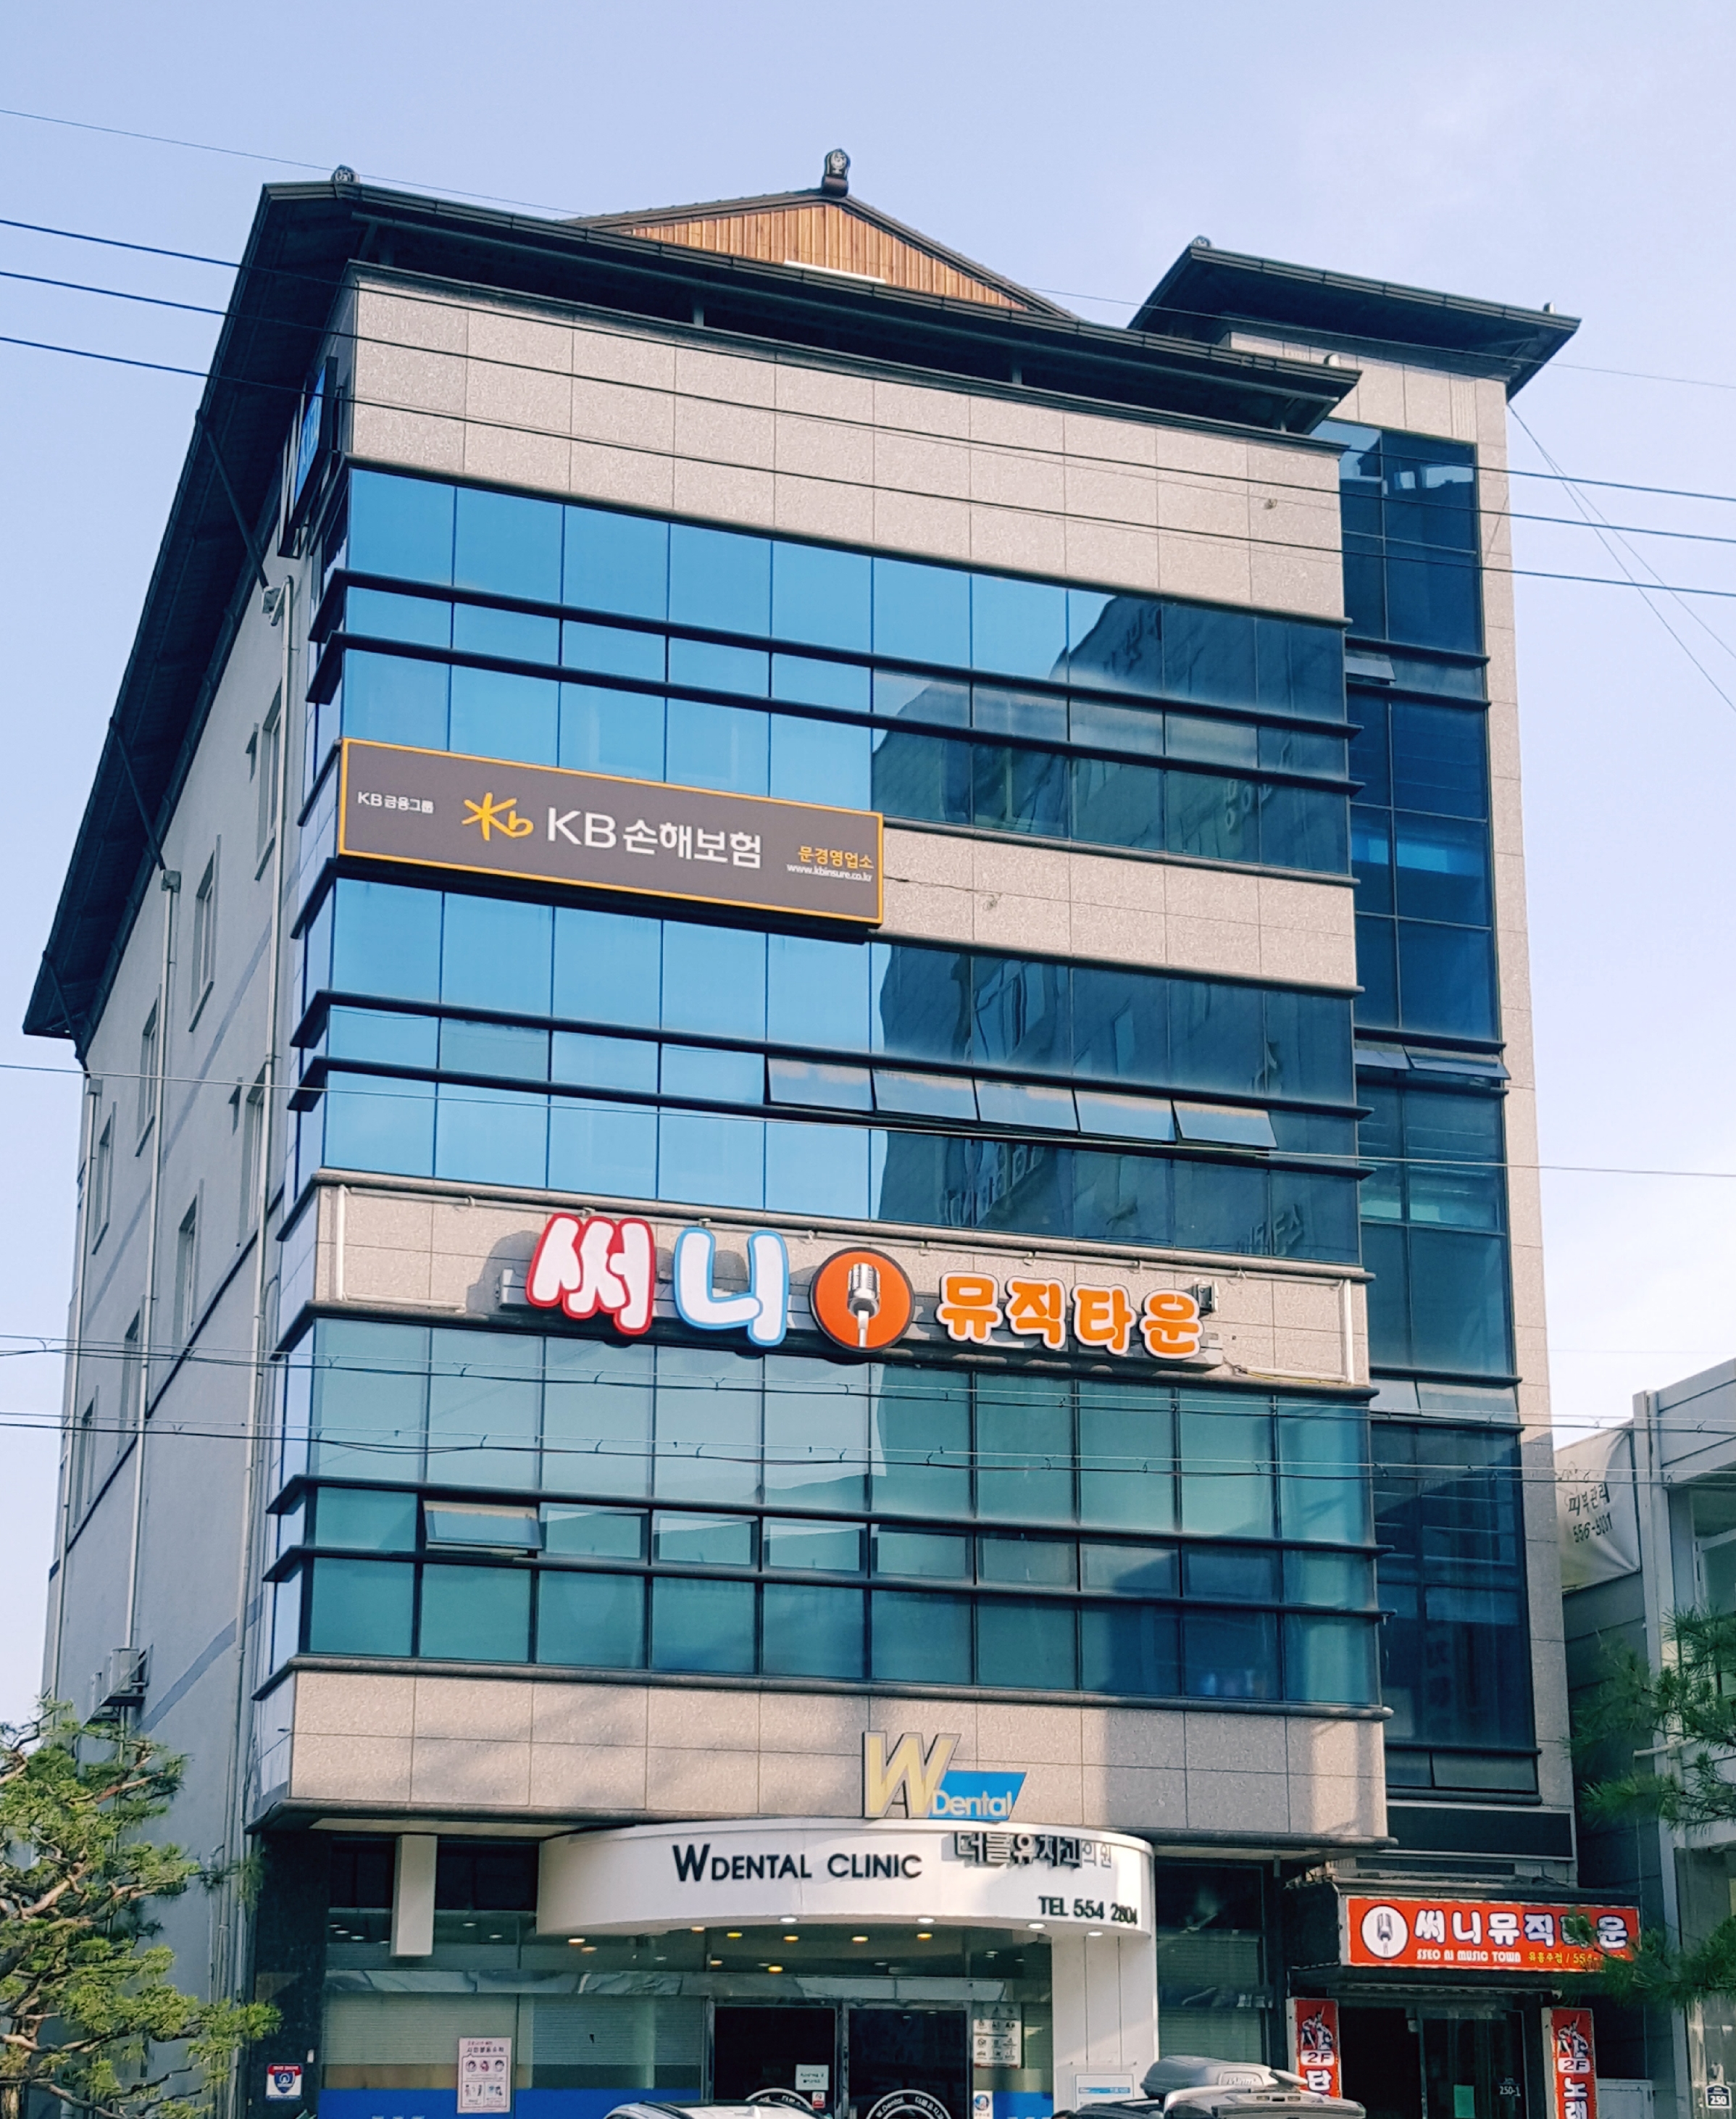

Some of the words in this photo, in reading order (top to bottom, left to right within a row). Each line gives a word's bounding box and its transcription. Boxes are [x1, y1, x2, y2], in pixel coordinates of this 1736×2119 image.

[798, 845, 874, 870] 문경영업소
[785, 863, 872, 882] www.kbinsure.co.kr
[525, 1212, 790, 1346] 써니
[936, 1271, 1204, 1360] 뮤직타운
[862, 1731, 961, 1819] W
[932, 1789, 1012, 1817] Dental
[827, 1853, 922, 1879] CLINIC
[1038, 1896, 1069, 1916] TEL
[1073, 1899, 1105, 1920] 554
[1457, 1950, 1488, 1962] MUSIC
[1308, 2052, 1331, 2063] 2F
[1564, 2060, 1587, 2070] 2F
[1710, 2095, 1727, 2105] 250
